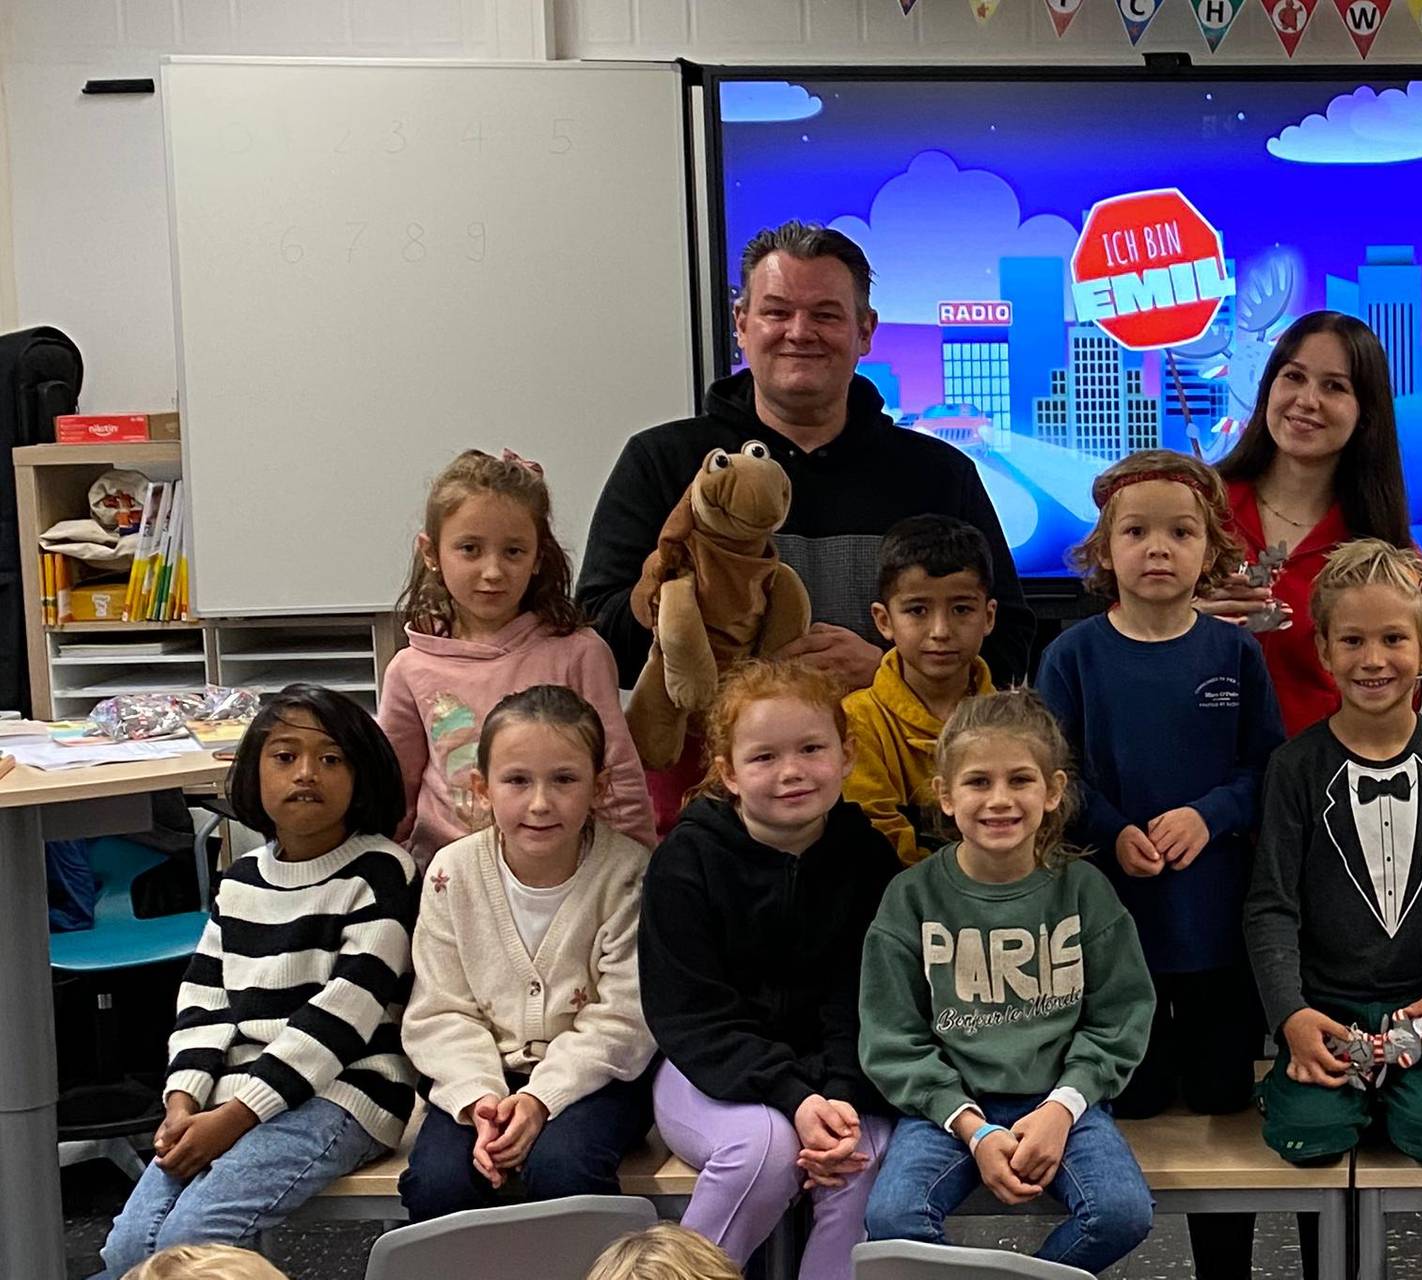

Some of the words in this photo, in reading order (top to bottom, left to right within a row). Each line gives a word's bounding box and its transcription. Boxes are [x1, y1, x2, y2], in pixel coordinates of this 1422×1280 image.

[384, 120, 408, 155] 3
[461, 121, 489, 155] 4
[548, 118, 576, 155] 5
[279, 224, 305, 264] 6
[344, 221, 369, 265] 7
[401, 222, 427, 263] 8
[465, 221, 487, 263] 9
[1101, 229, 1140, 268] ICH
[1142, 219, 1182, 260] BIN
[1071, 255, 1237, 323] EMIL
[940, 304, 1010, 321] RADIO
[921, 914, 1084, 1003] PARIS
